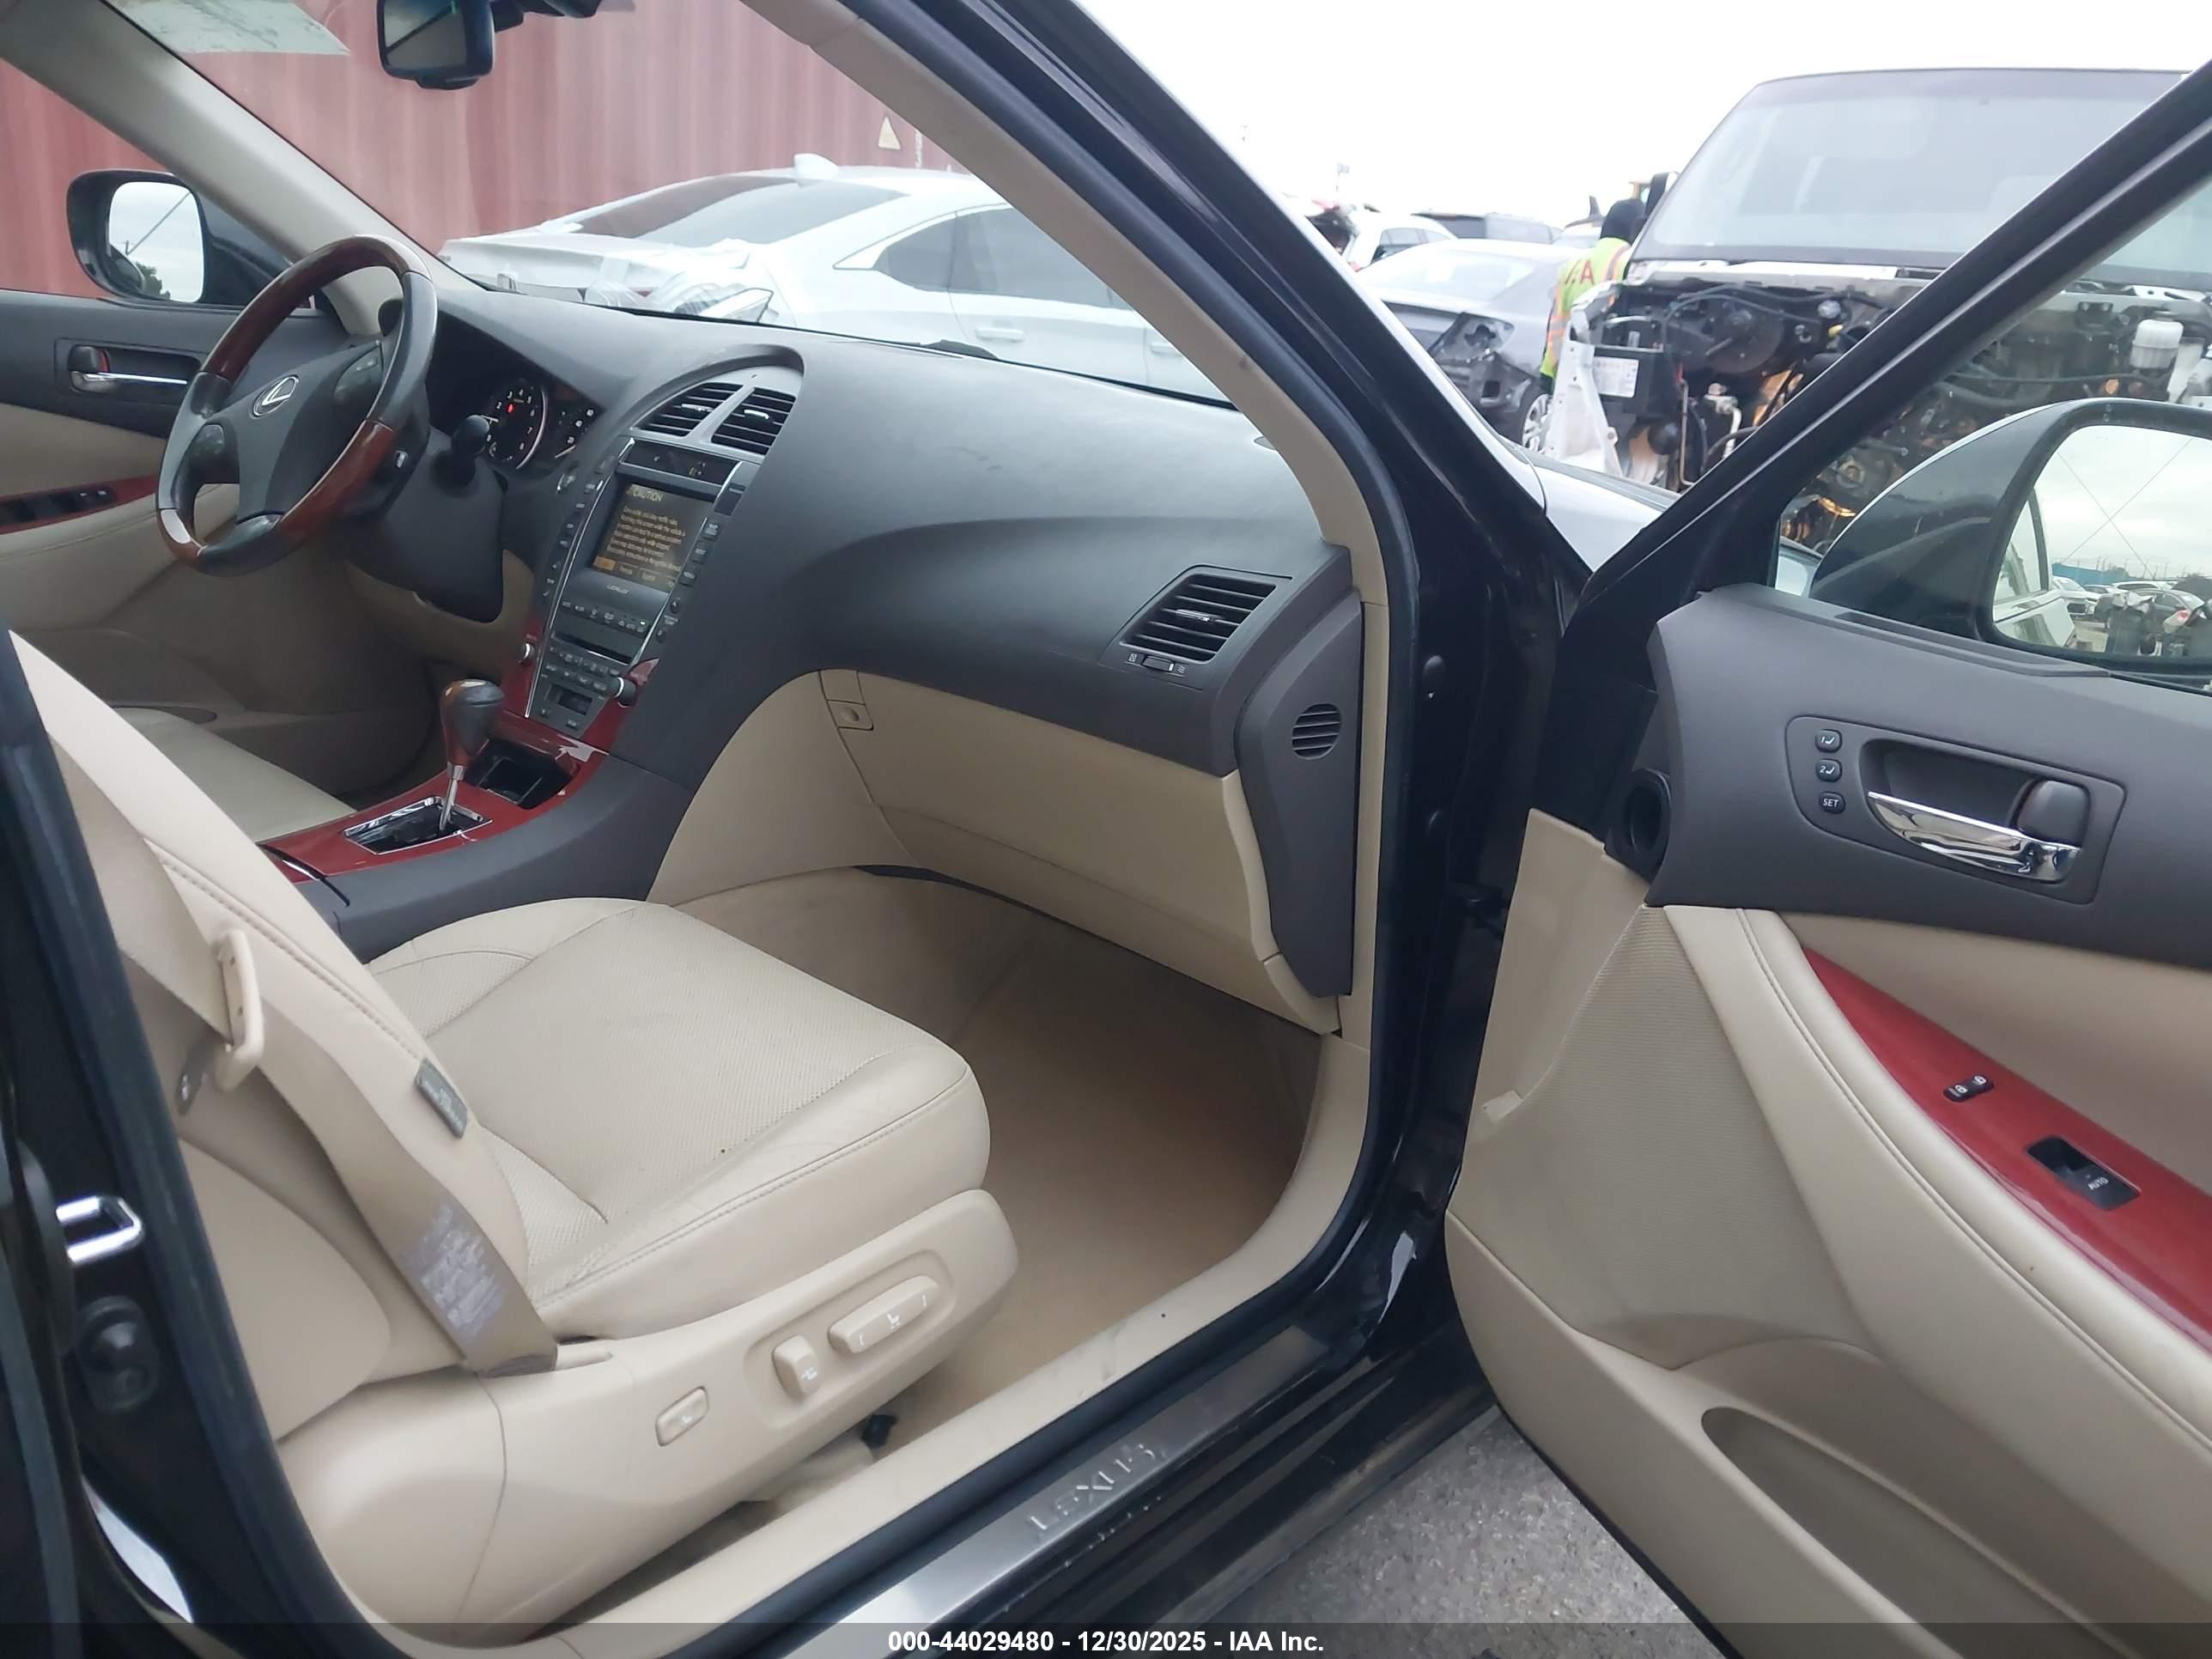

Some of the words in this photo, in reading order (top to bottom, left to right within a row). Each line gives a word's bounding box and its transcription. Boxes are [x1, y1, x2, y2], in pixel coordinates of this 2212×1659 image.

[632, 489, 664, 501] CAUTION
[1823, 798, 1839, 808] SET
[2088, 1176, 2109, 1190] AUTO
